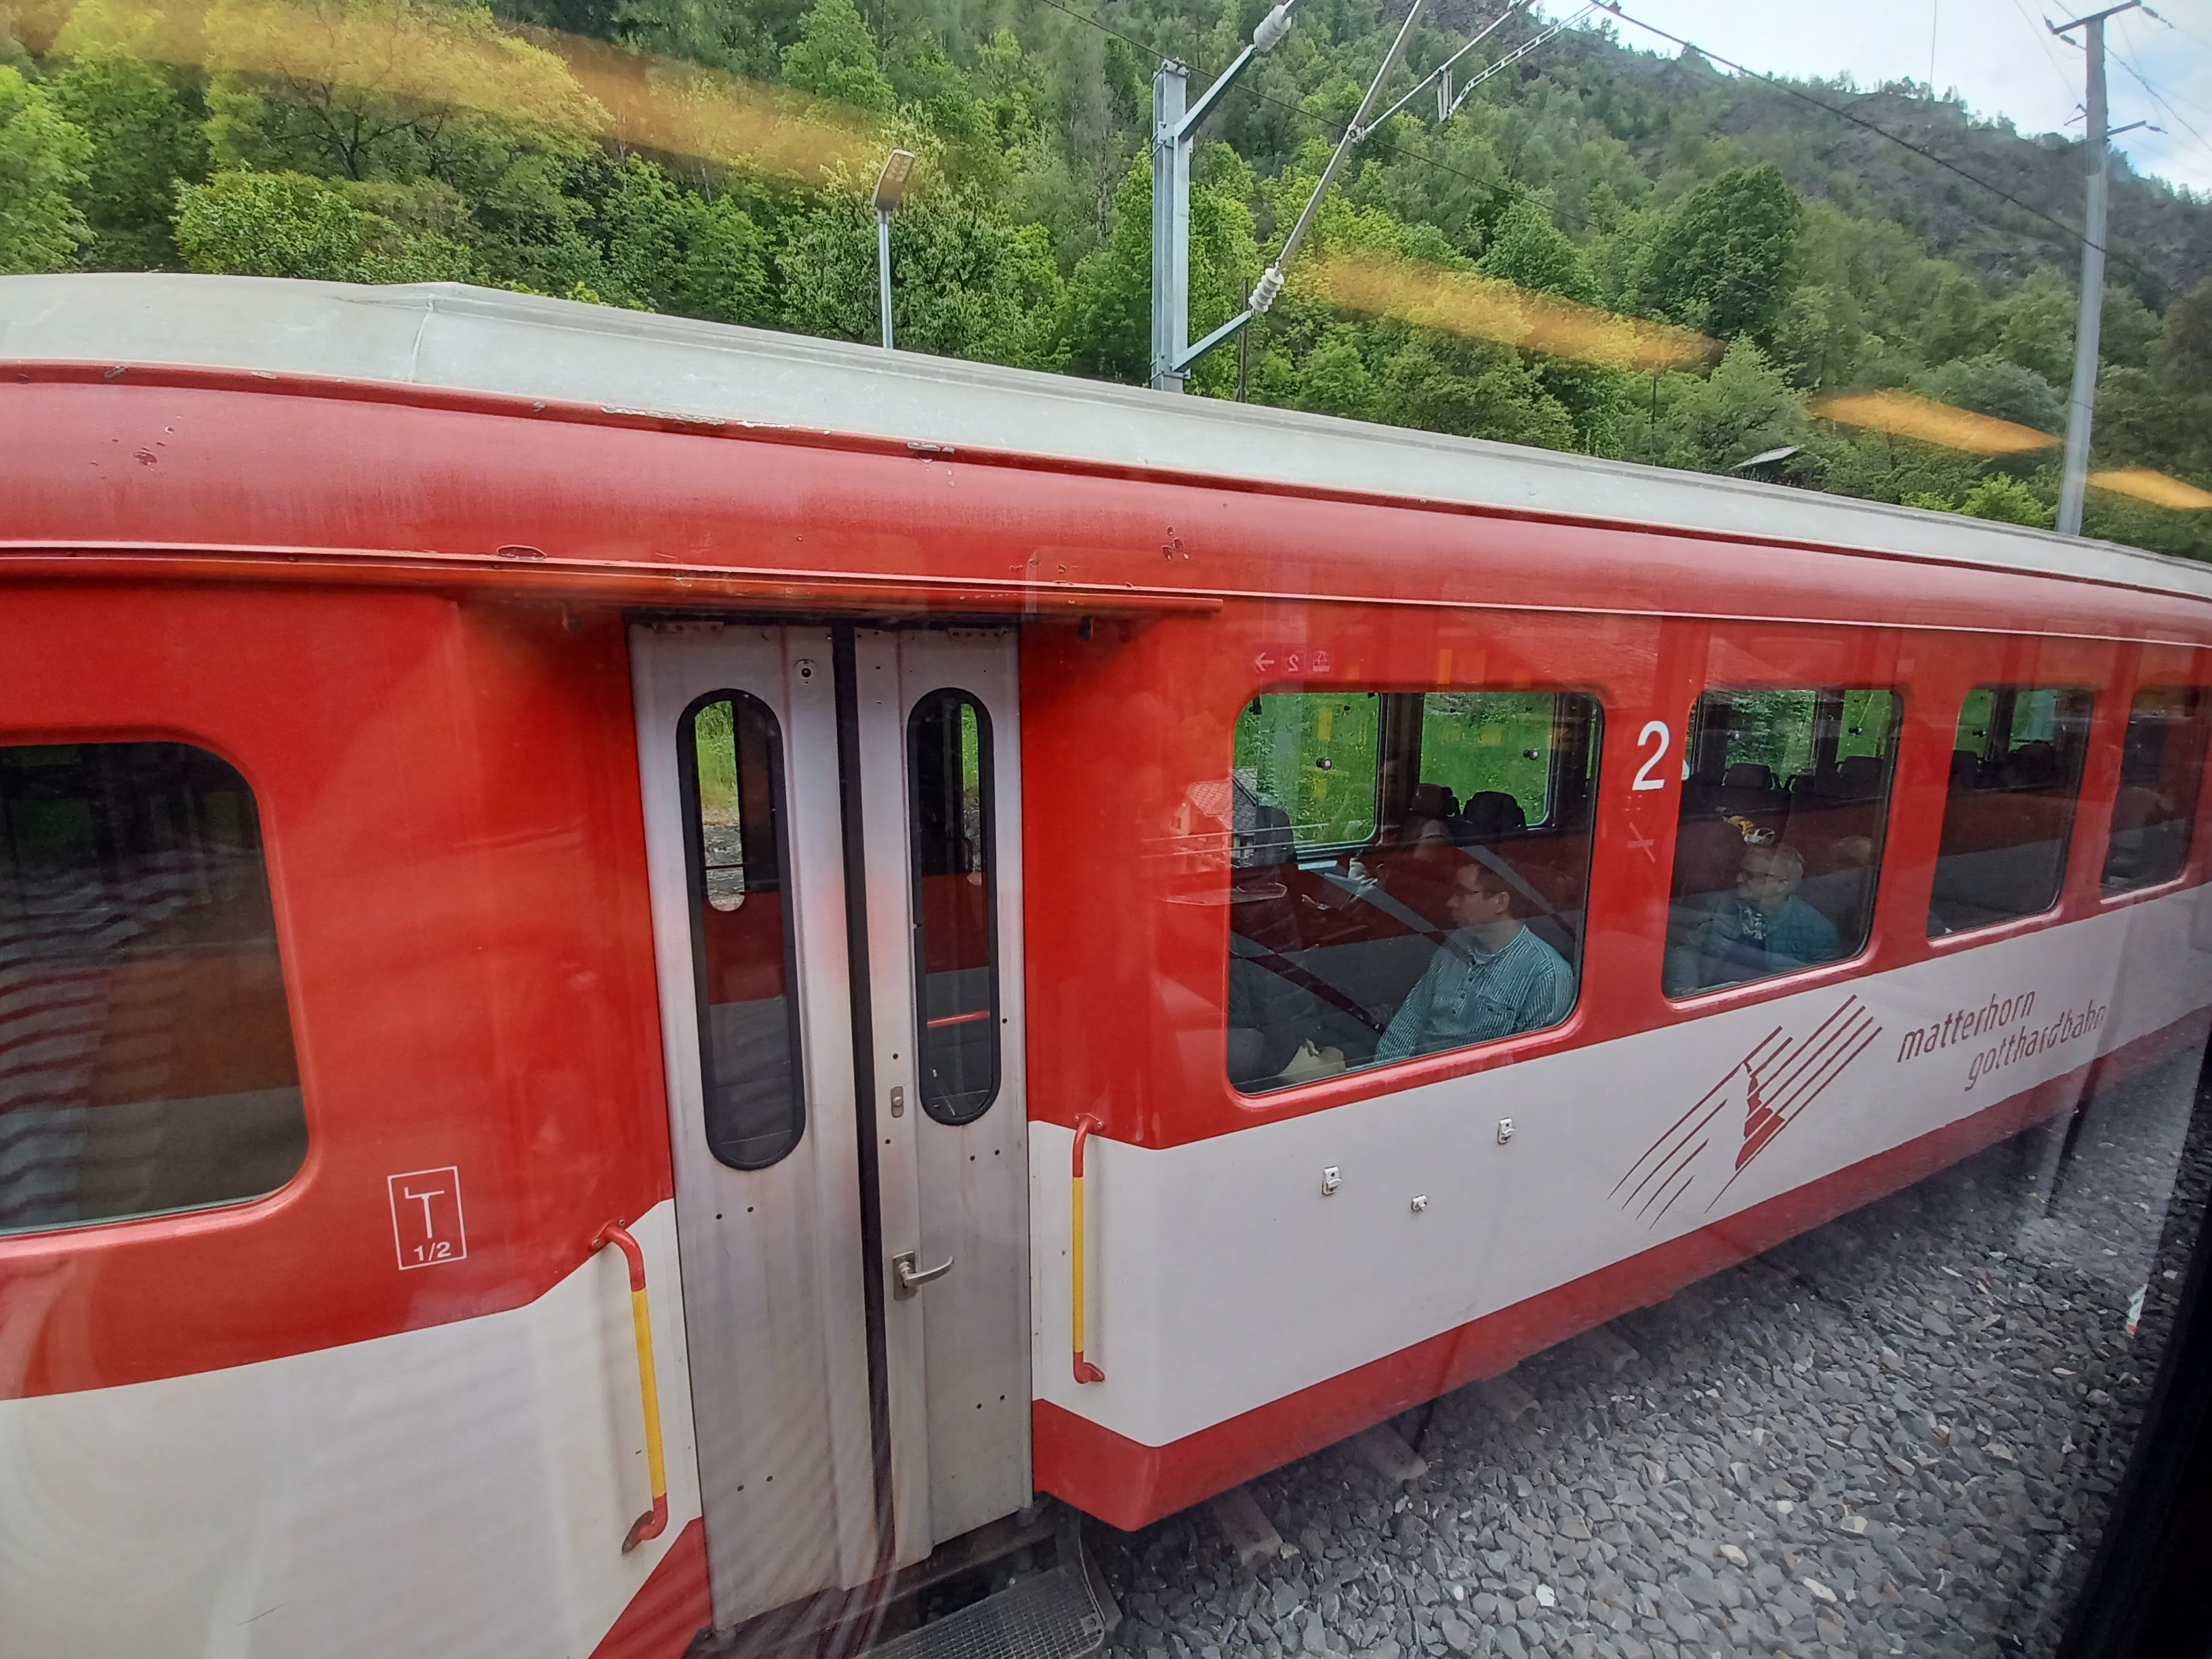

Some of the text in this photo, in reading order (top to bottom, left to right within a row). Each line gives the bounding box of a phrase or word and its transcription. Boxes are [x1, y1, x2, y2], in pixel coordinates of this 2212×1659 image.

[1632, 720, 1670, 791] 2
[1897, 990, 2036, 1063] matterhorn
[1964, 999, 2106, 1092] gotthardbahn
[413, 1241, 451, 1262] 1/2
